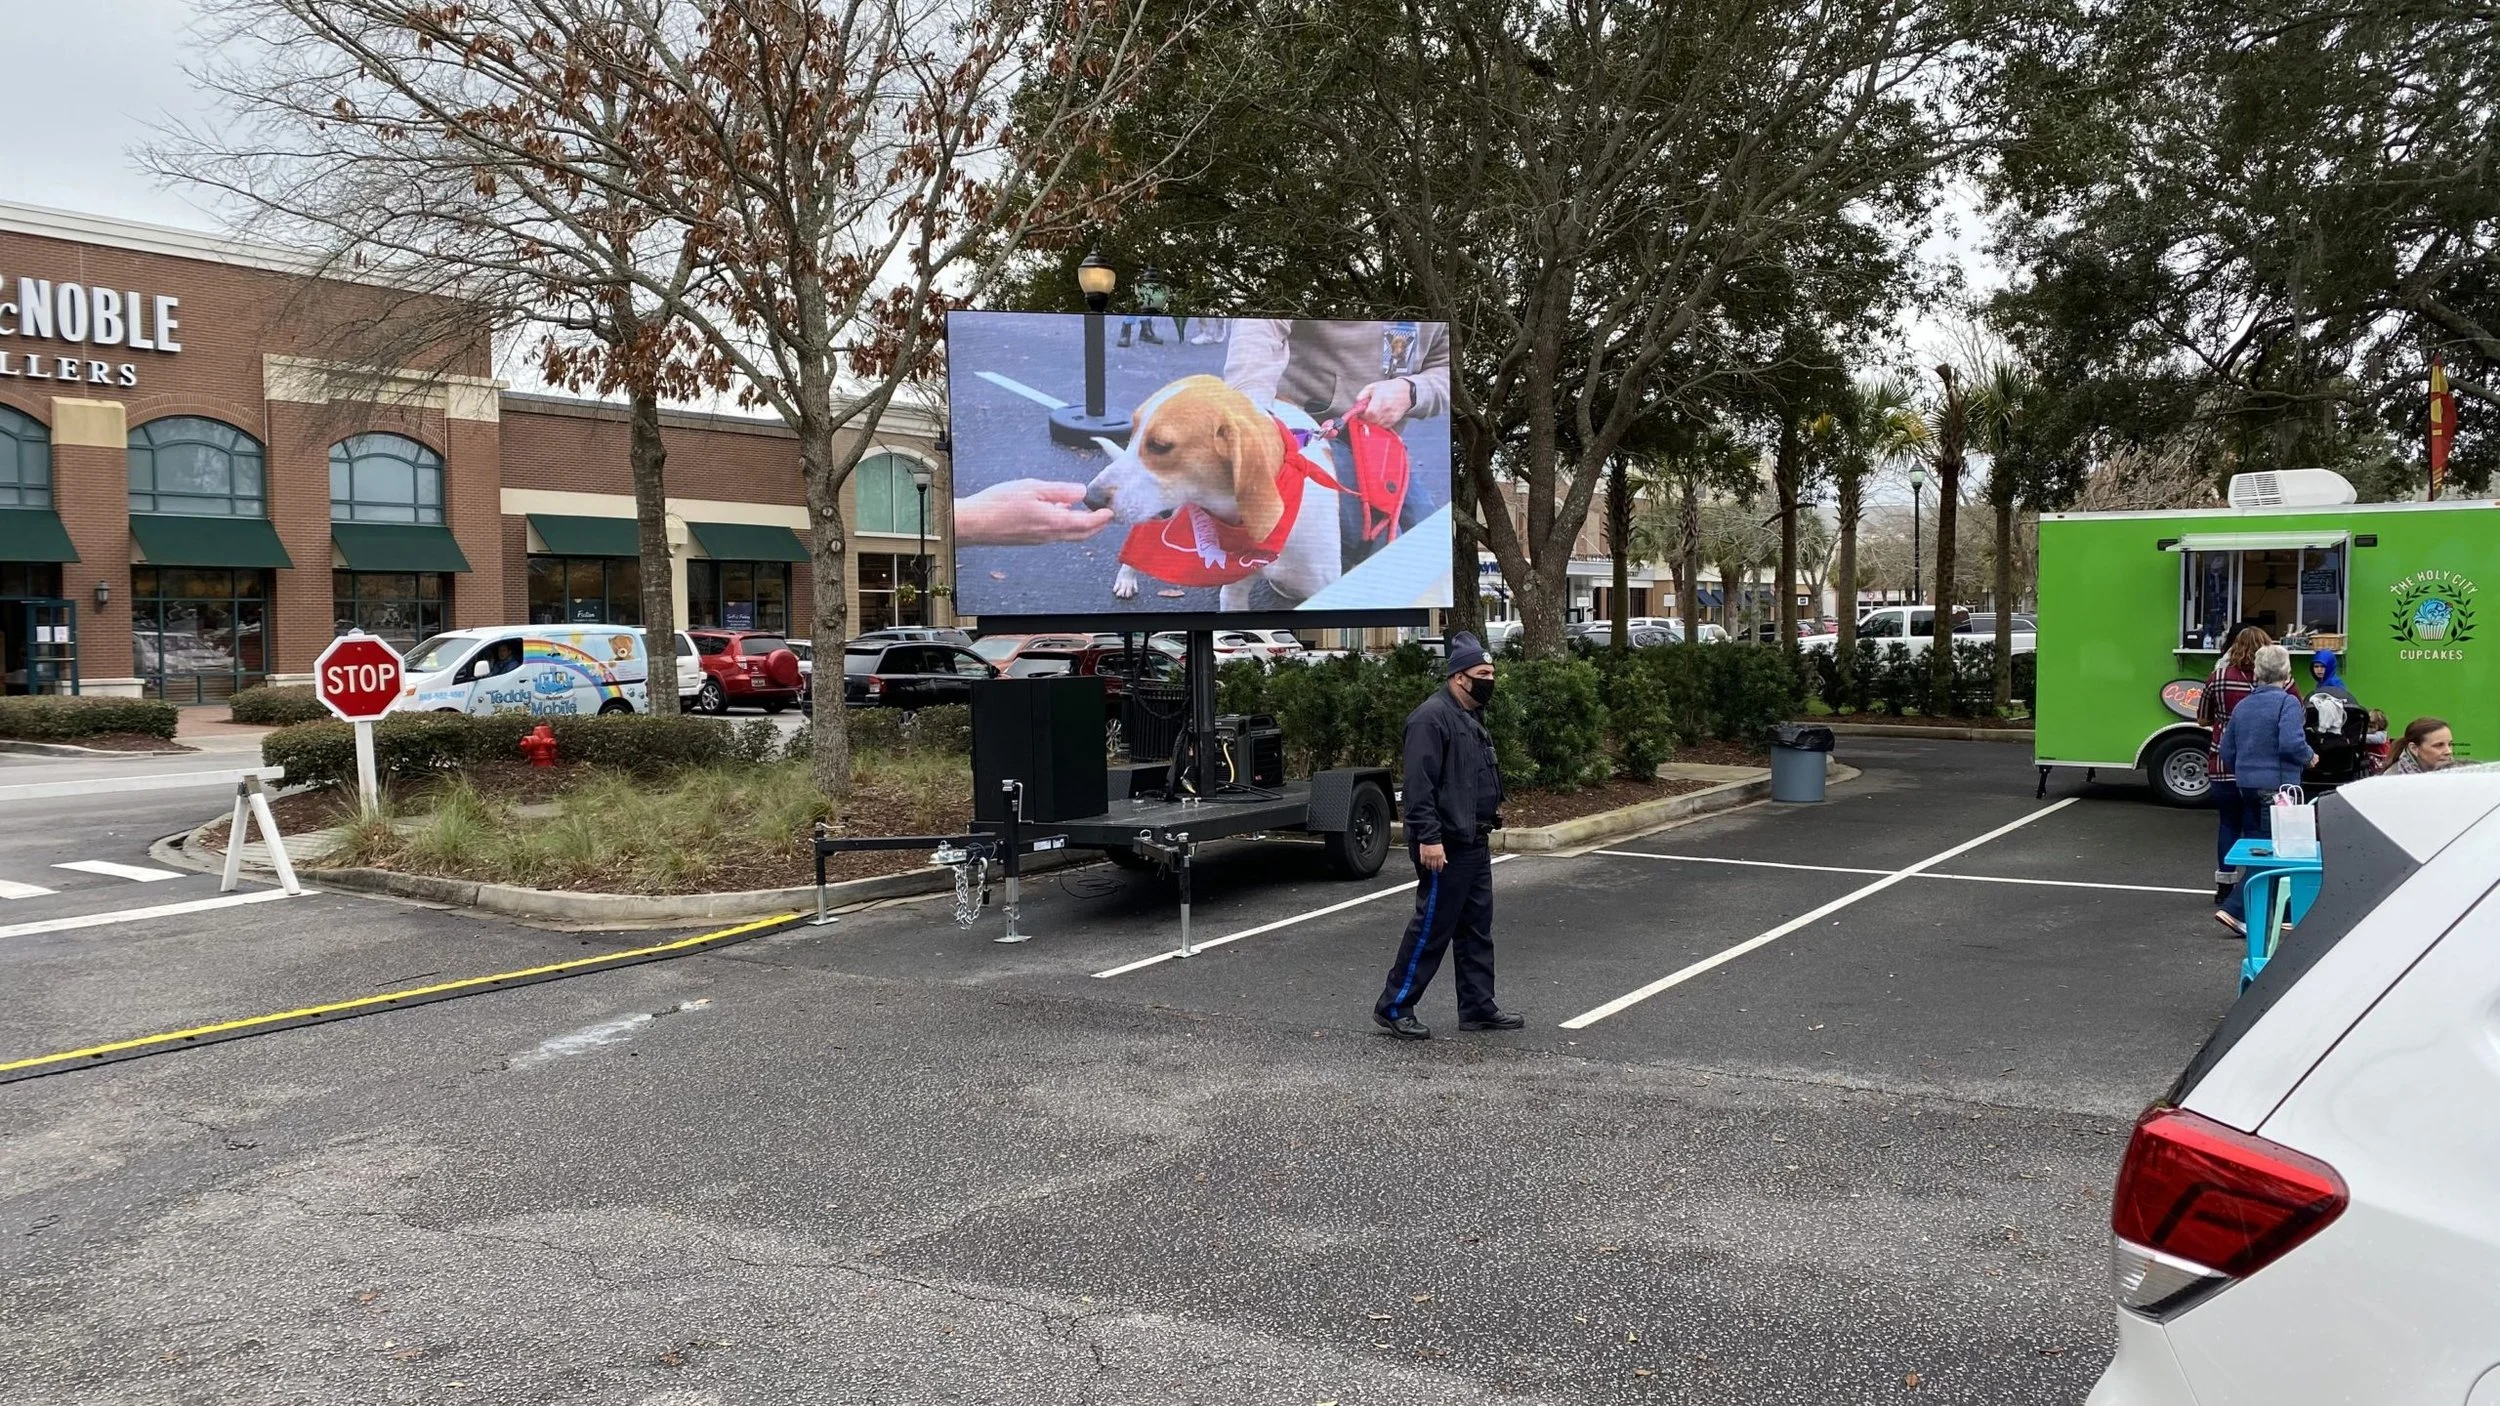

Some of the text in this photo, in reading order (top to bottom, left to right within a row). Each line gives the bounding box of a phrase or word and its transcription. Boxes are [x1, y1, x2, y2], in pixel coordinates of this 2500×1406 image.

[18, 276, 182, 352] NOBLE
[2390, 570, 2478, 595] THE HOLY CITY
[2400, 649, 2463, 660] CUPCAKES
[326, 663, 395, 695] STOP
[486, 689, 532, 706] Teddy
[531, 699, 577, 716] Mobile
